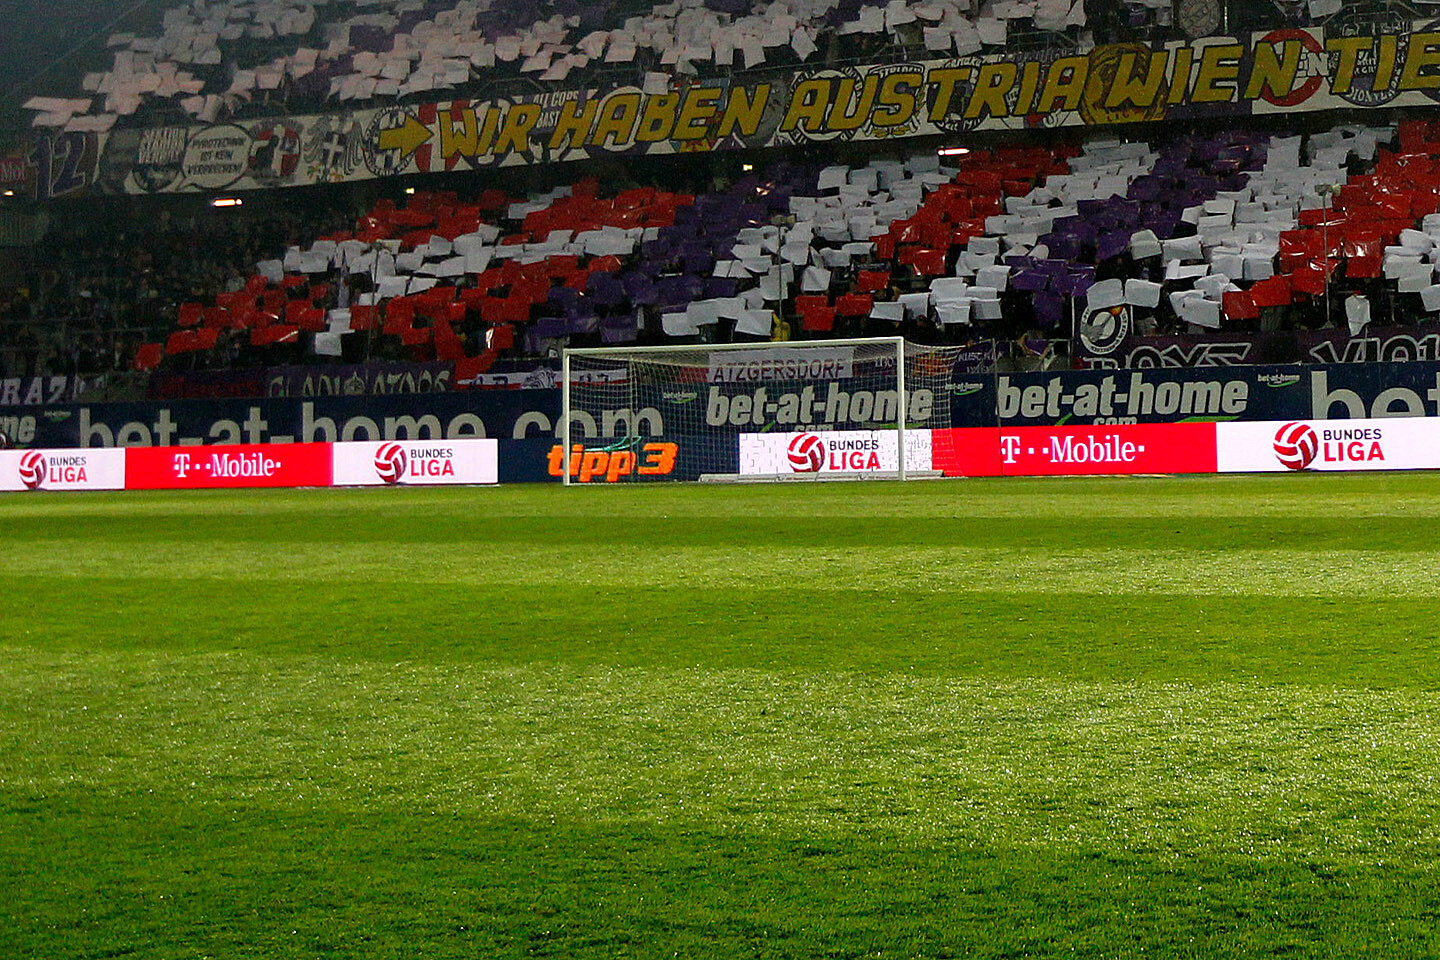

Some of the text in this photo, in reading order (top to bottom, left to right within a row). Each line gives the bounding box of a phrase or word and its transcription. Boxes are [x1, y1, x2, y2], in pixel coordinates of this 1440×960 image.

[439, 104, 542, 158] WIR
[548, 84, 771, 149] HABEN
[779, 55, 1090, 132] AUSTRIA
[1102, 40, 1299, 108] WIEN
[713, 357, 847, 382] ATZGERSDORF
[998, 372, 1248, 418] bet-at-home
[706, 382, 933, 426] bet-at-home
[1324, 428, 1382, 441] BUNDES
[410, 448, 453, 459] BUNDES
[830, 440, 879, 451] BUNDES
[1324, 442, 1385, 461] LIGA
[50, 456, 87, 466] BUNDES
[411, 460, 455, 476] LIGA
[830, 452, 880, 470] LIGA
[50, 467, 87, 483] LIGA
